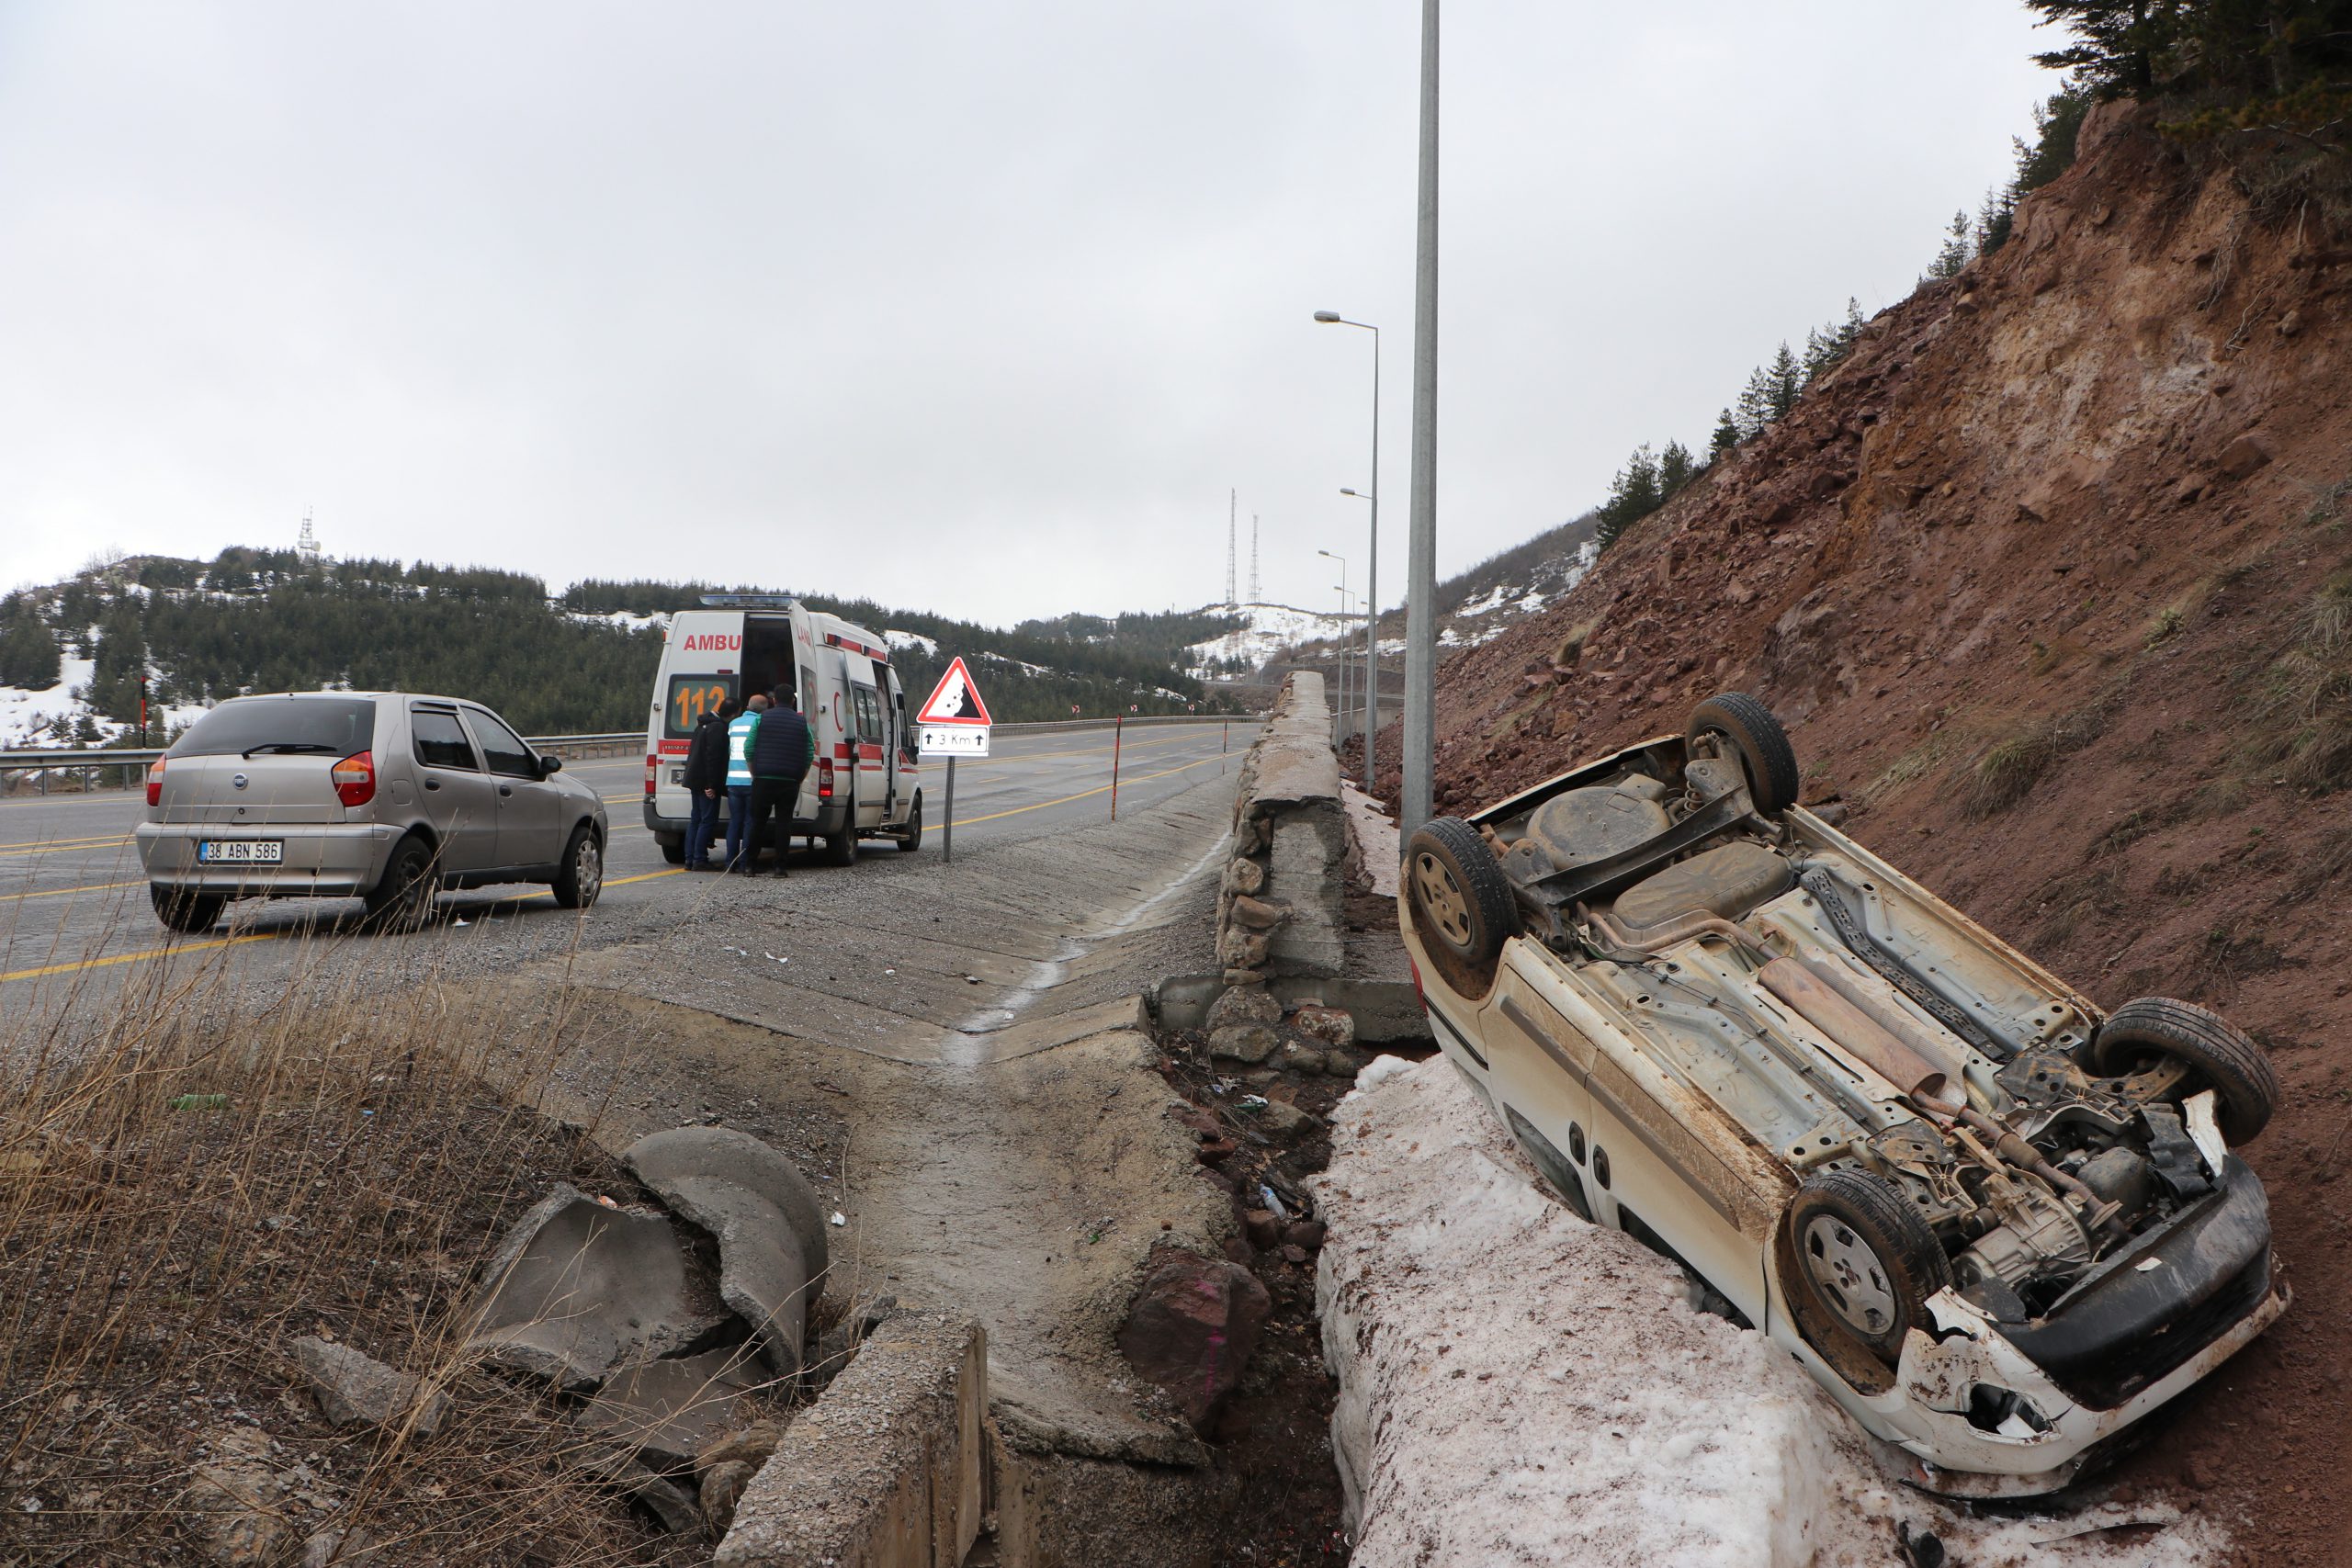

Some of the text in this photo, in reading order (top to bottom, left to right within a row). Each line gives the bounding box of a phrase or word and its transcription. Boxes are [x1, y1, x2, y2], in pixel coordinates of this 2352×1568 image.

[683, 634, 742, 651] AMBU
[675, 685, 726, 728] 112
[939, 734, 971, 745] 3 Km
[209, 843, 277, 859] 38 ABN 586
